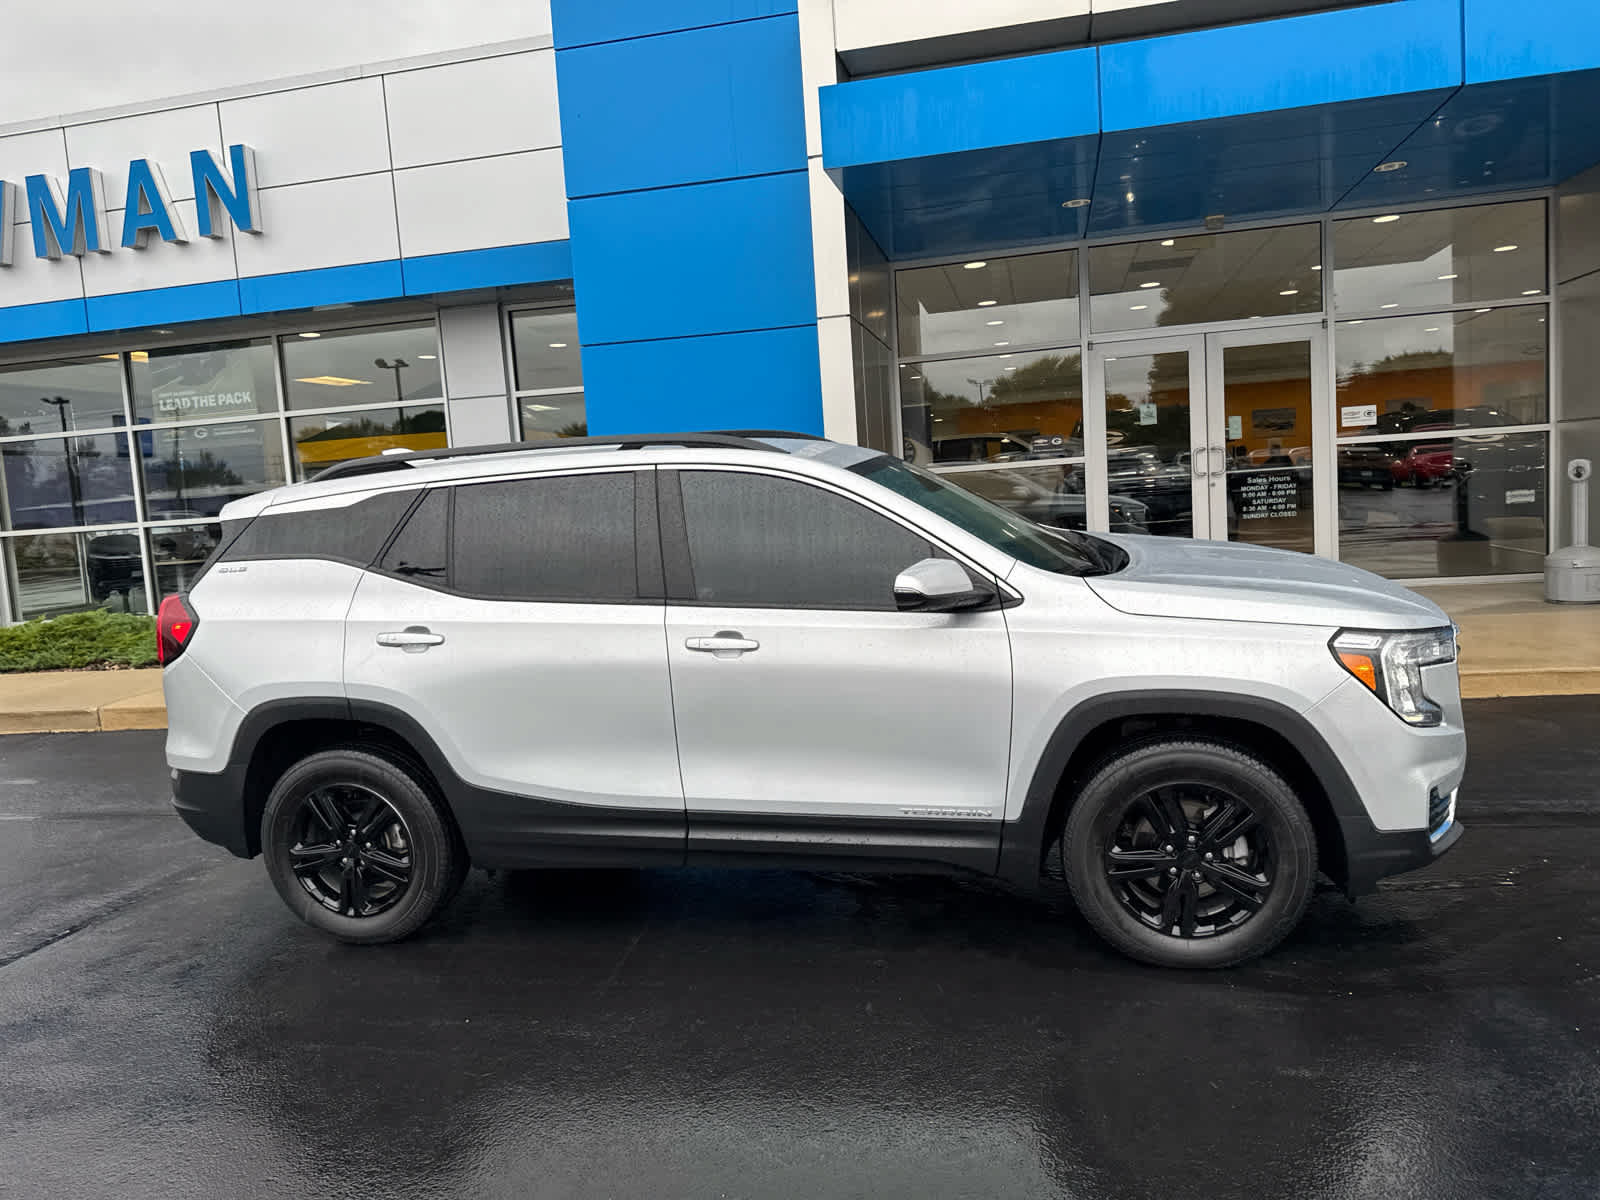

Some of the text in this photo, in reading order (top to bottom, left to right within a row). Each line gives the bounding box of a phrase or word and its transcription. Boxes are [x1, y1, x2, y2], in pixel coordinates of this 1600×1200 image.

[0, 143, 262, 268] MAN
[159, 391, 252, 411] LEAD THE PACK
[1247, 476, 1267, 484] Sales
[1240, 484, 1269, 492] MONDAY
[1252, 497, 1287, 505] SATURDAY
[1270, 510, 1297, 518] CLOSED
